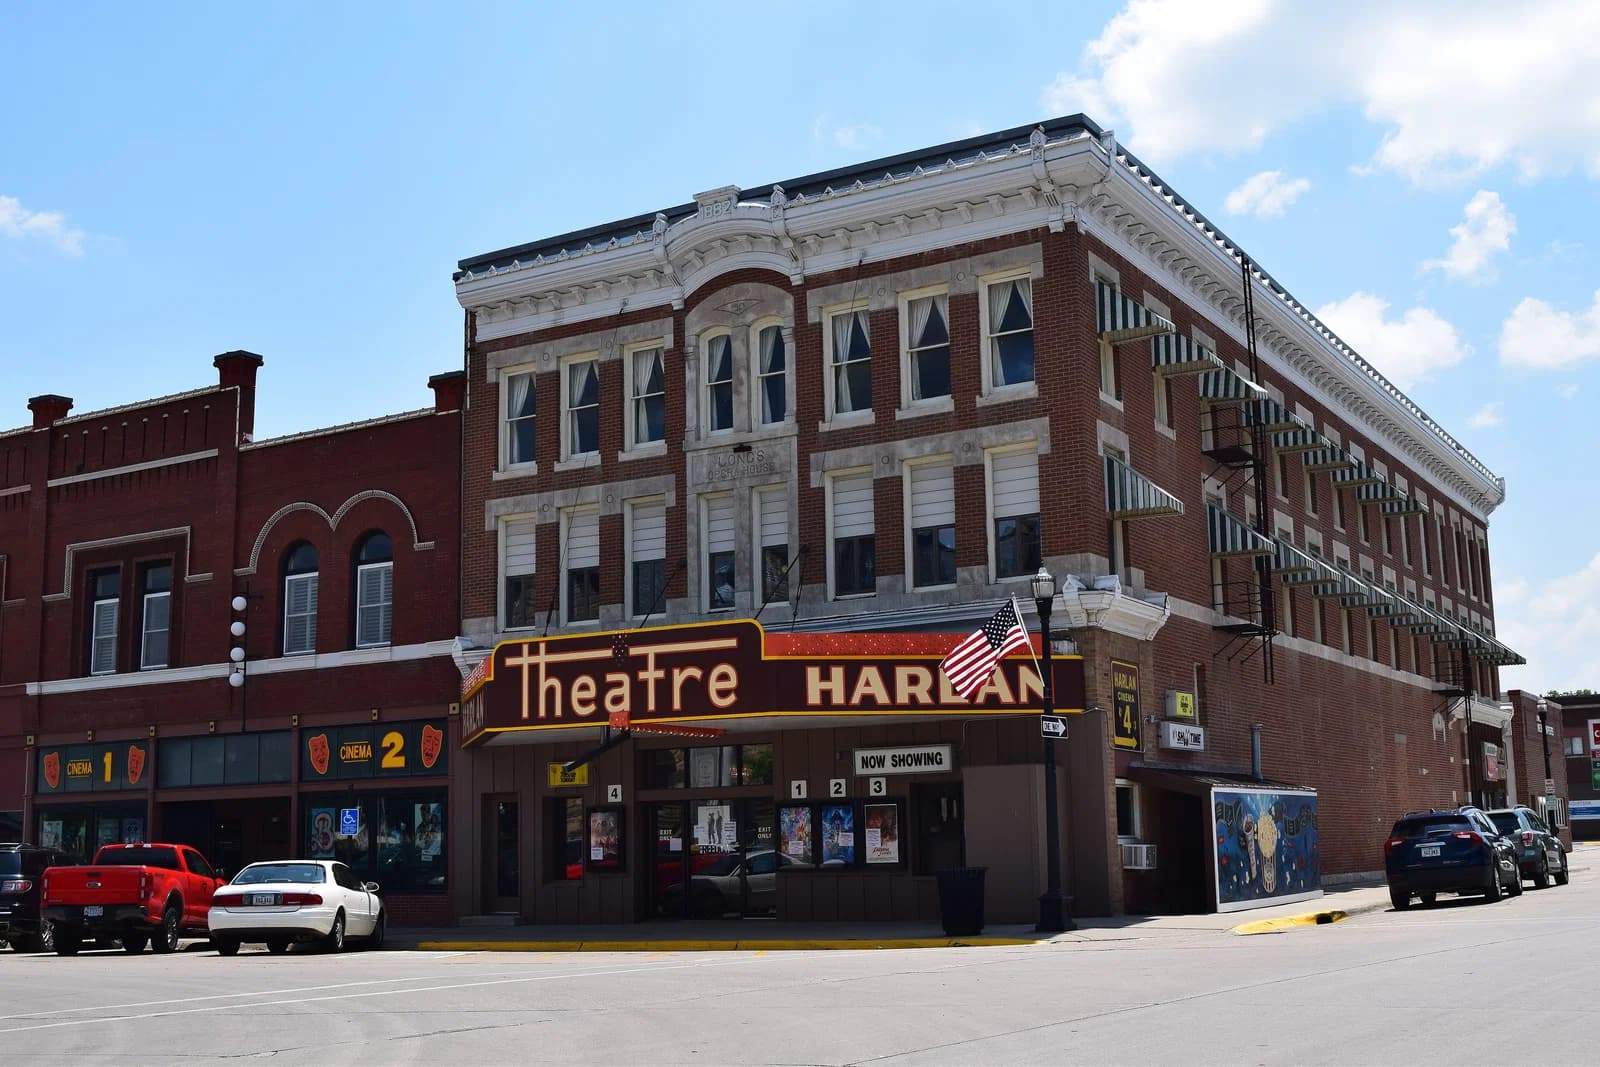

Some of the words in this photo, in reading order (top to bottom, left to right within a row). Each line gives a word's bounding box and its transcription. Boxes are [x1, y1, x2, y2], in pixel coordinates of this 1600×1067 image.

[1114, 672, 1136, 690] HARLAN
[1118, 691, 1135, 702] CINEMA
[1123, 705, 1132, 734] 4
[340, 745, 372, 760] CINEMA
[381, 731, 406, 768] 2
[67, 762, 92, 776] CINEMA
[104, 752, 112, 782] 1
[861, 755, 886, 769] NOW
[890, 752, 943, 768] SHOWING
[611, 788, 618, 799] 4
[795, 784, 802, 796] 1
[834, 783, 842, 795] 2
[874, 781, 883, 793] 3
